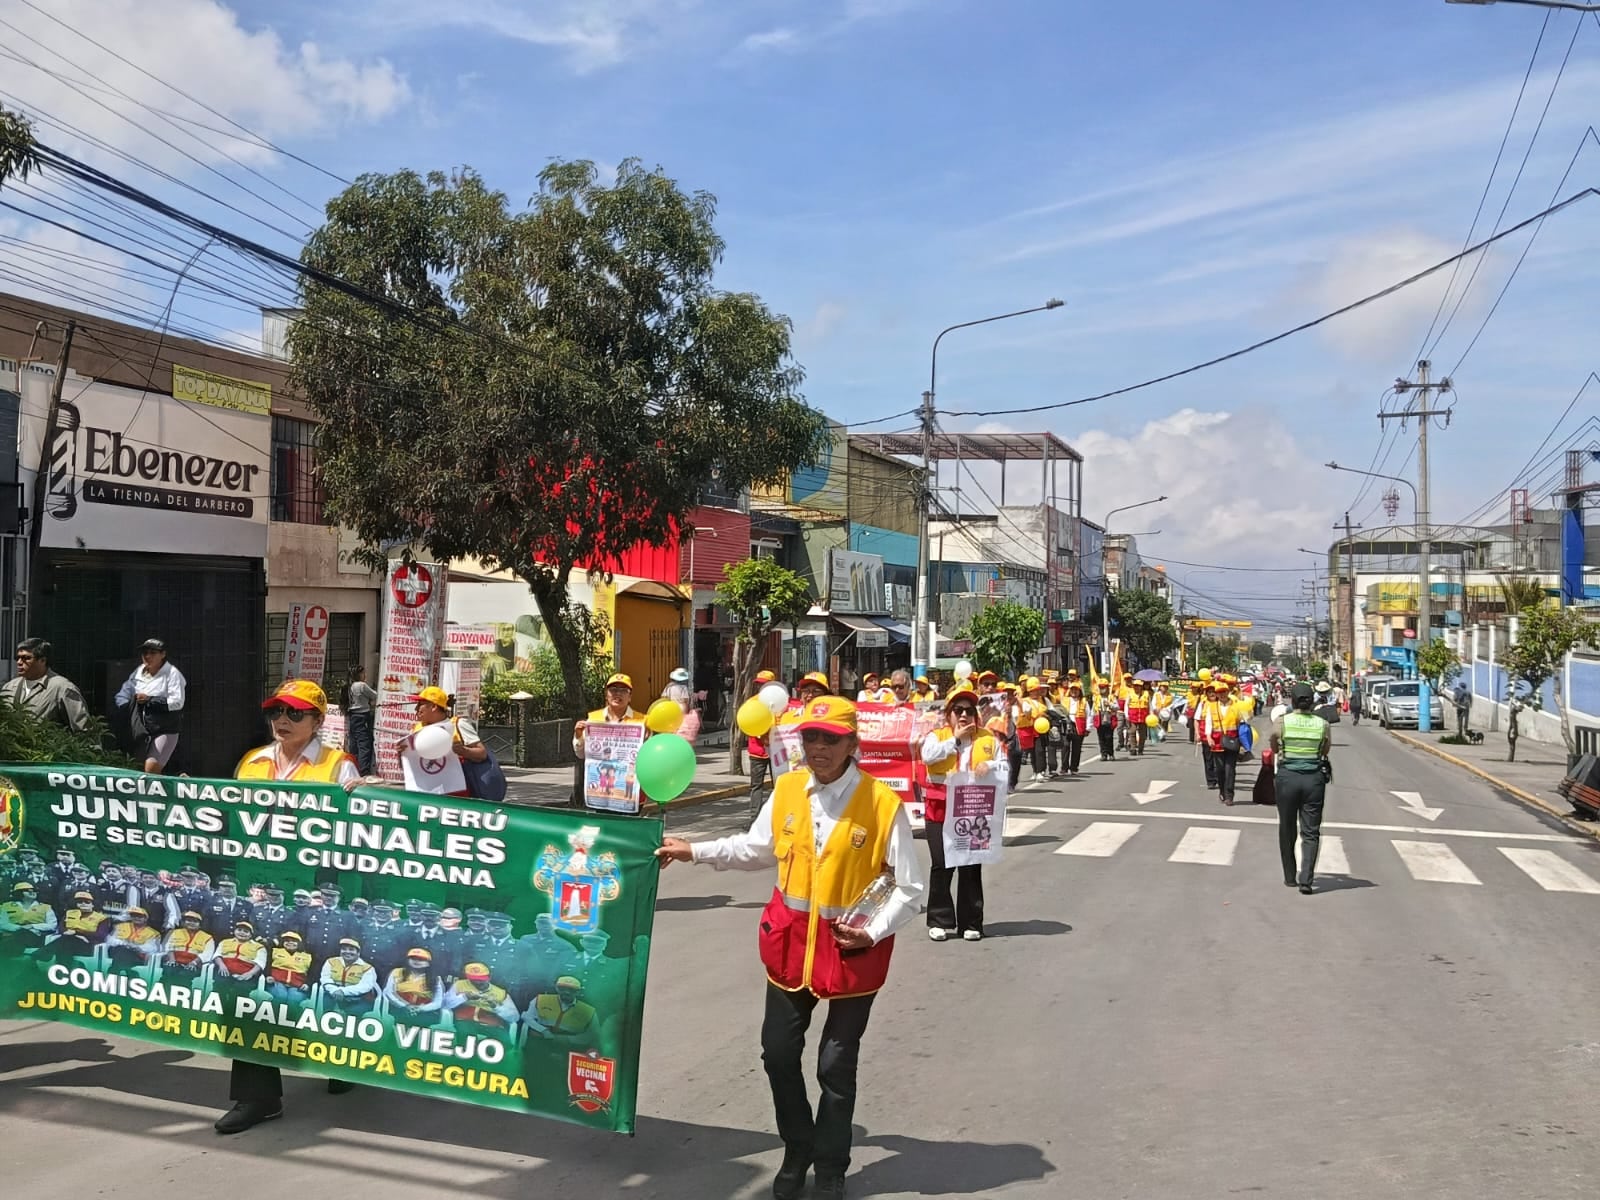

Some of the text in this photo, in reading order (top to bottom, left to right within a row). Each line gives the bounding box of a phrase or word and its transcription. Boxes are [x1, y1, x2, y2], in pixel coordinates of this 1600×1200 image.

[175, 374, 206, 396] TOP
[207, 381, 268, 409] DAYANA
[84, 427, 258, 492] Ebenezer
[90, 486, 245, 513] LA TIENDA DEL BARBERO
[452, 633, 495, 646] DAYANA
[48, 772, 509, 832] POLICÍA NACIONAL DEL PERÚ
[50, 794, 506, 865] JUNTAS VECINALES
[57, 820, 496, 889] DE SEGURIDAD CIUDADANA
[47, 964, 505, 1063] COMISARIA PALACIO VIEJO
[18, 992, 529, 1098] JUNTOS POR UNA AREQUIPA SEGURA
[575, 1067, 607, 1082] VECINAL
